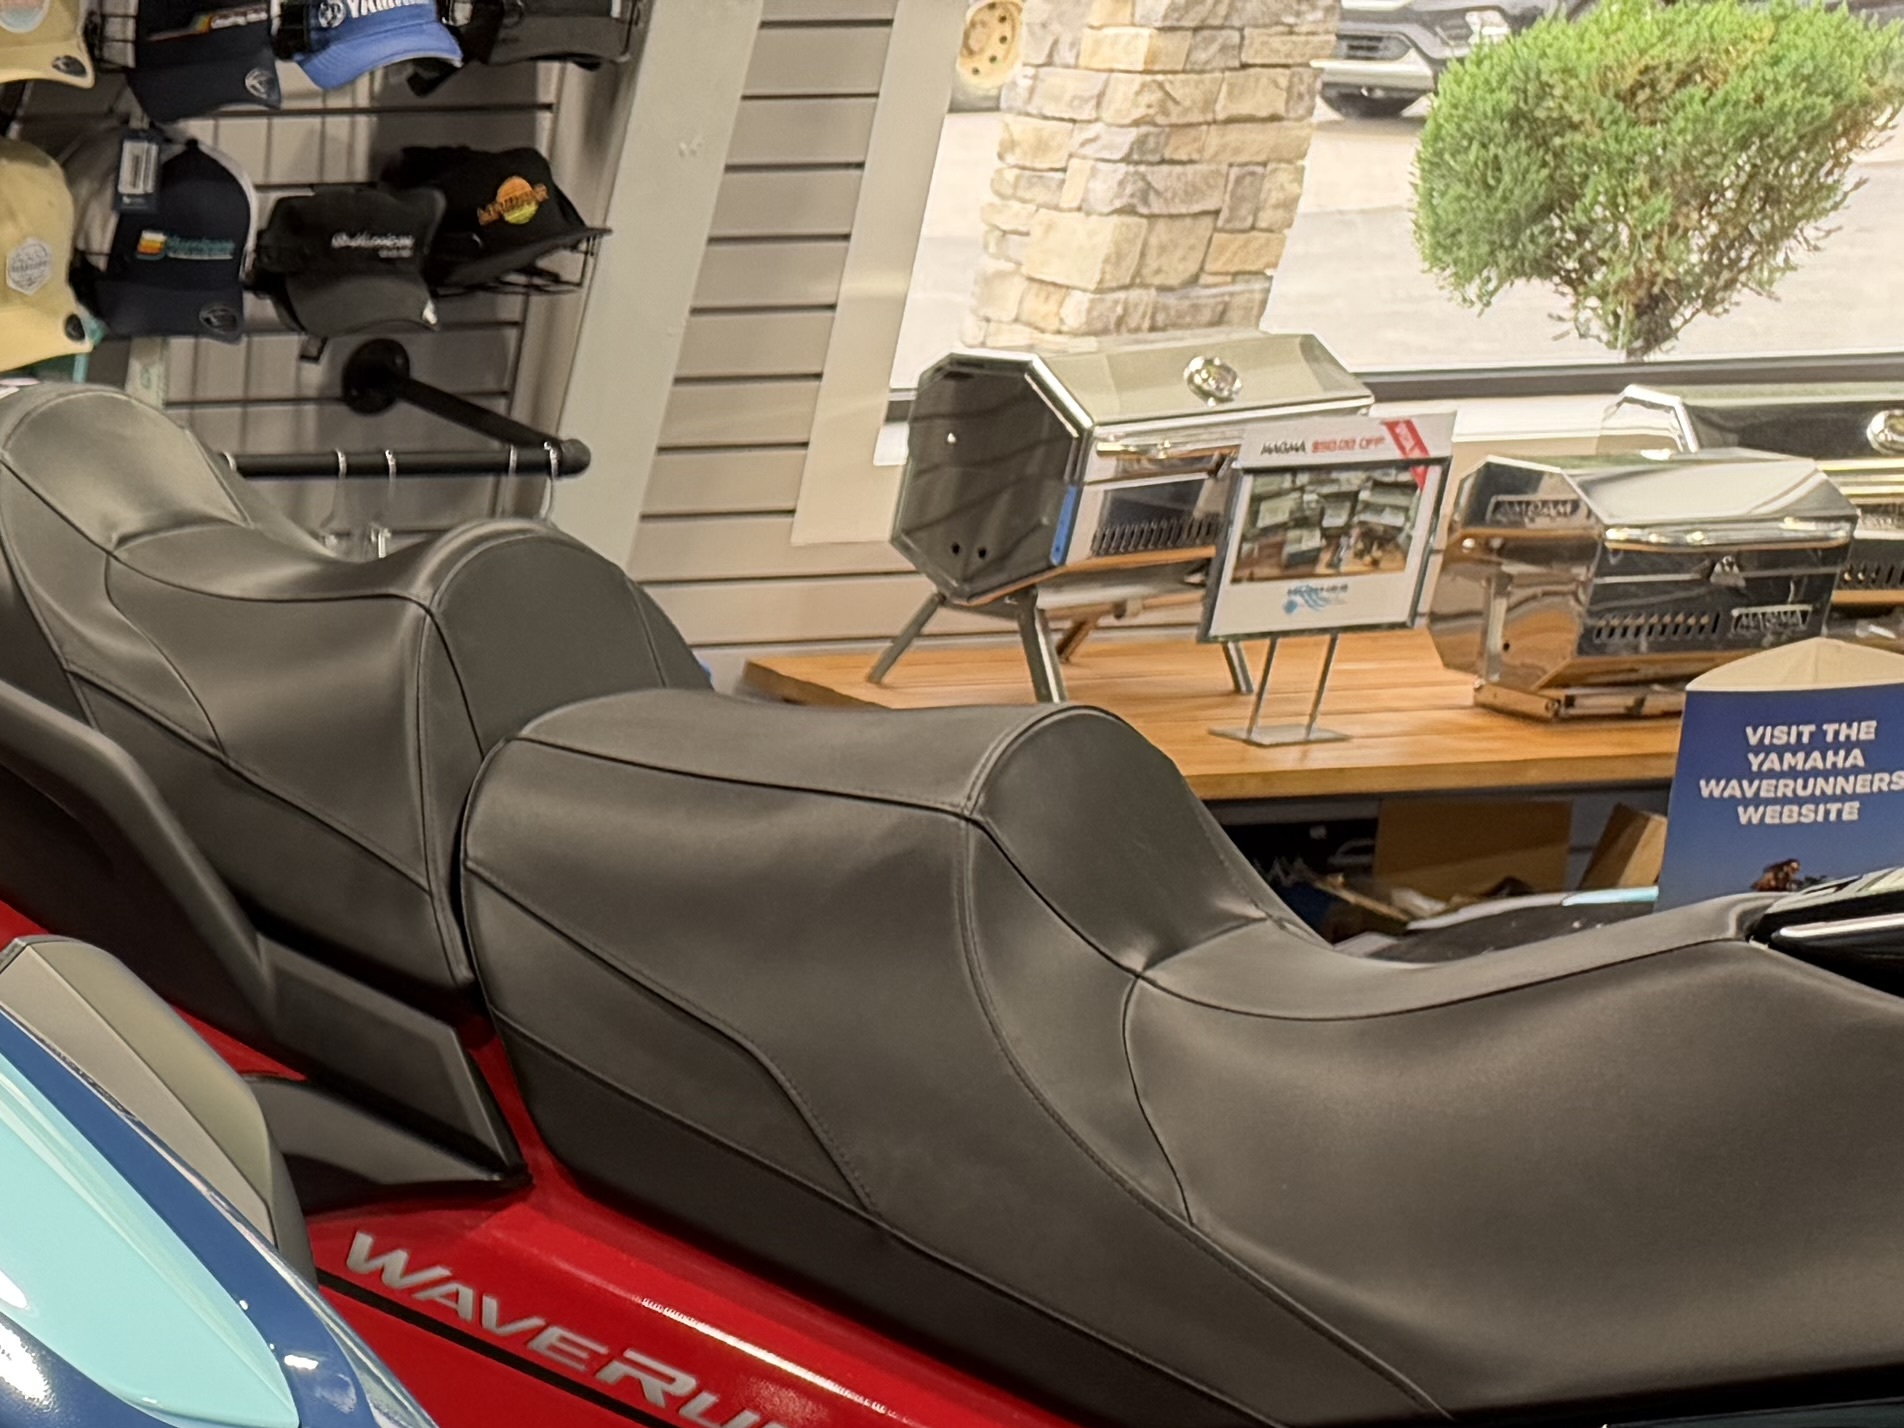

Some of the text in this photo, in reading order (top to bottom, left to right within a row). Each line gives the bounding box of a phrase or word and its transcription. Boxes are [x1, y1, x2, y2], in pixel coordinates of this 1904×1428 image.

[1745, 720, 1878, 746] VISIT THE
[1747, 748, 1866, 772] YAMAHA
[1699, 770, 1904, 798] WAVERUNNERS
[1737, 801, 1860, 825] WEBSITE
